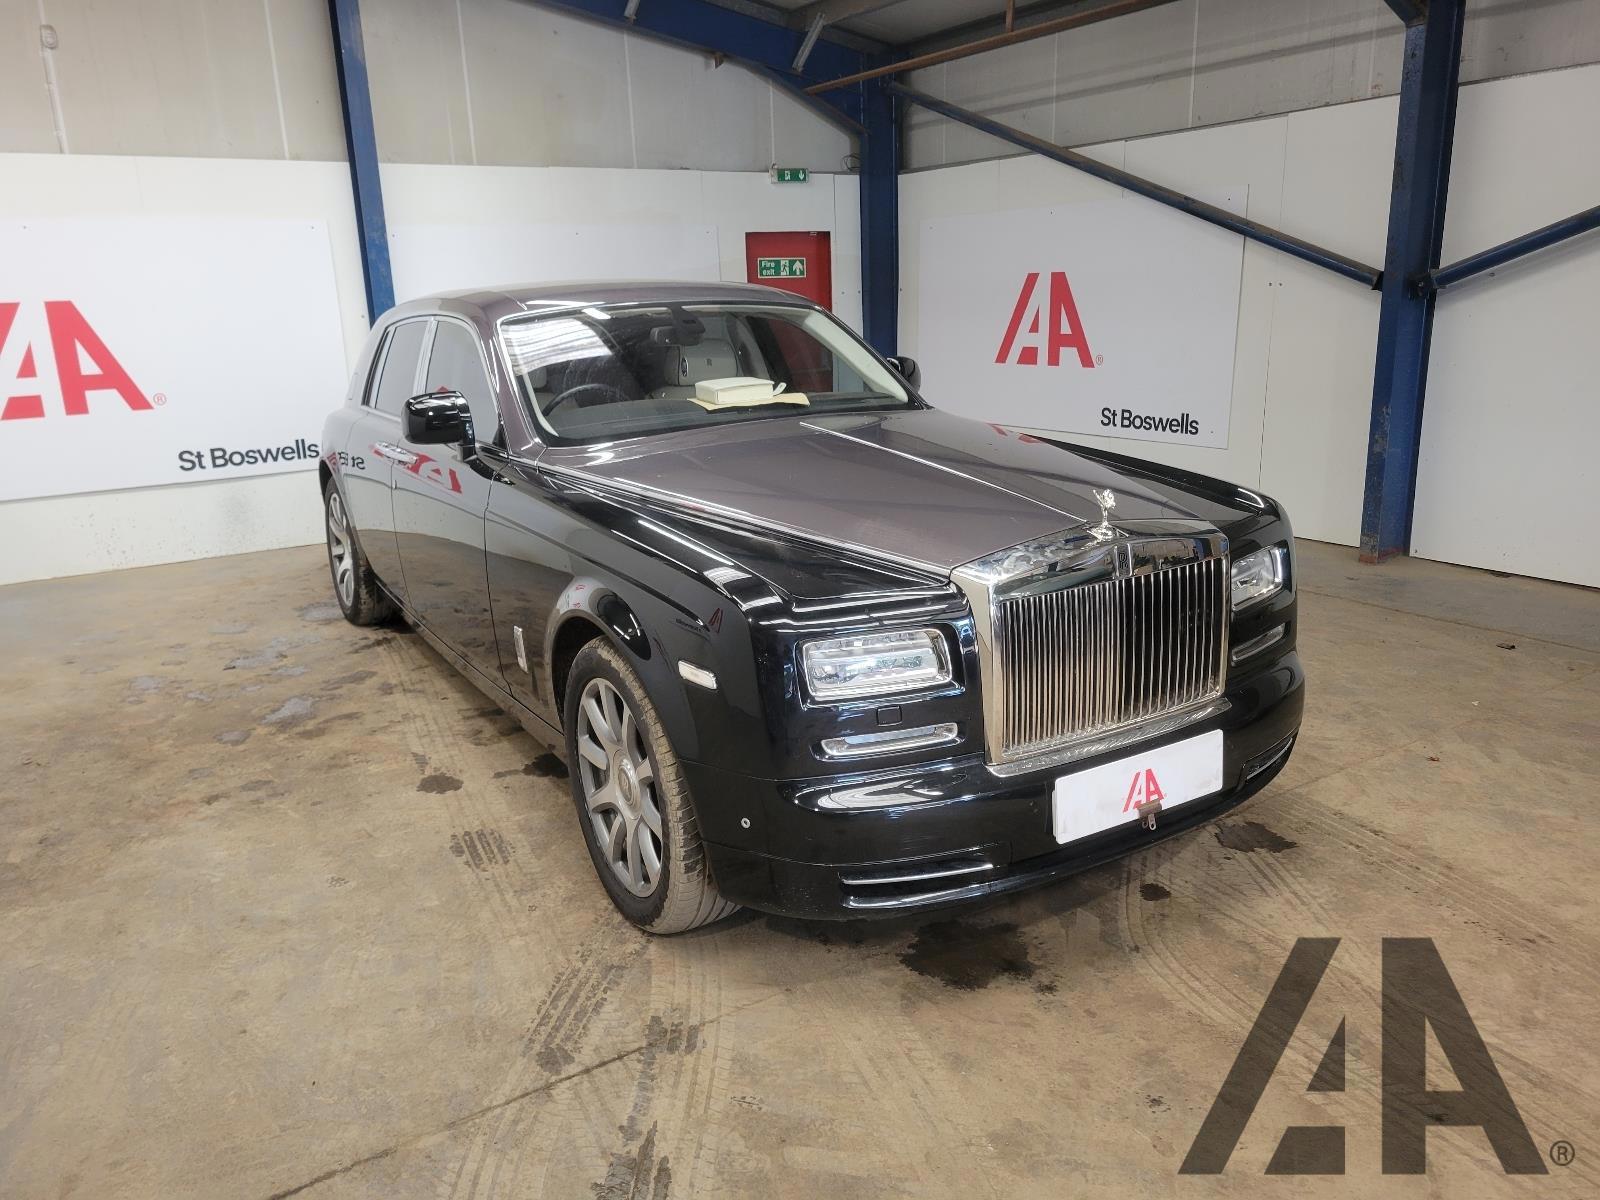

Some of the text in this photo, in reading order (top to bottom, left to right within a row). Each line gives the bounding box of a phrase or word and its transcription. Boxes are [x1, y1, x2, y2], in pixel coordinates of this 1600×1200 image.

[761, 260, 775, 268] Fire
[1100, 407, 1199, 435] St Boswells
[178, 450, 206, 471] St
[210, 438, 320, 468] Boswells
